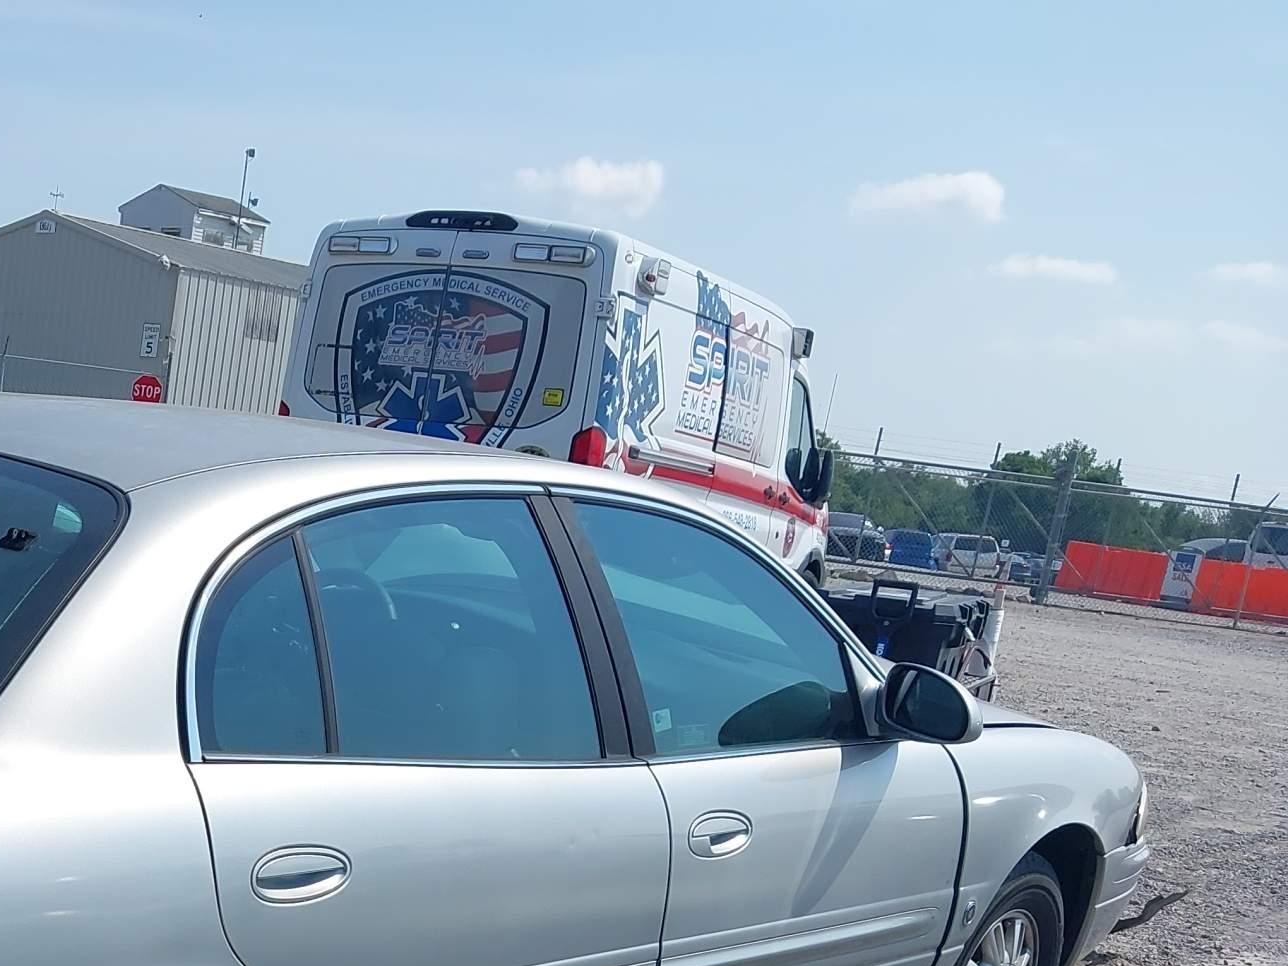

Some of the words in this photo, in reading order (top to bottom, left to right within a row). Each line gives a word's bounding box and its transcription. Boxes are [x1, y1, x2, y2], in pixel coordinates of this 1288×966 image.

[362, 278, 430, 301] EMERGENCY
[484, 285, 532, 312] SERVICE
[145, 342, 153, 354] 5
[424, 358, 470, 367] SRVICES
[686, 331, 770, 410] SPIRIT
[133, 383, 161, 398] STOP
[504, 387, 523, 418] OHIO
[676, 410, 713, 436] MEDICAL
[718, 422, 754, 447] SERVICES
